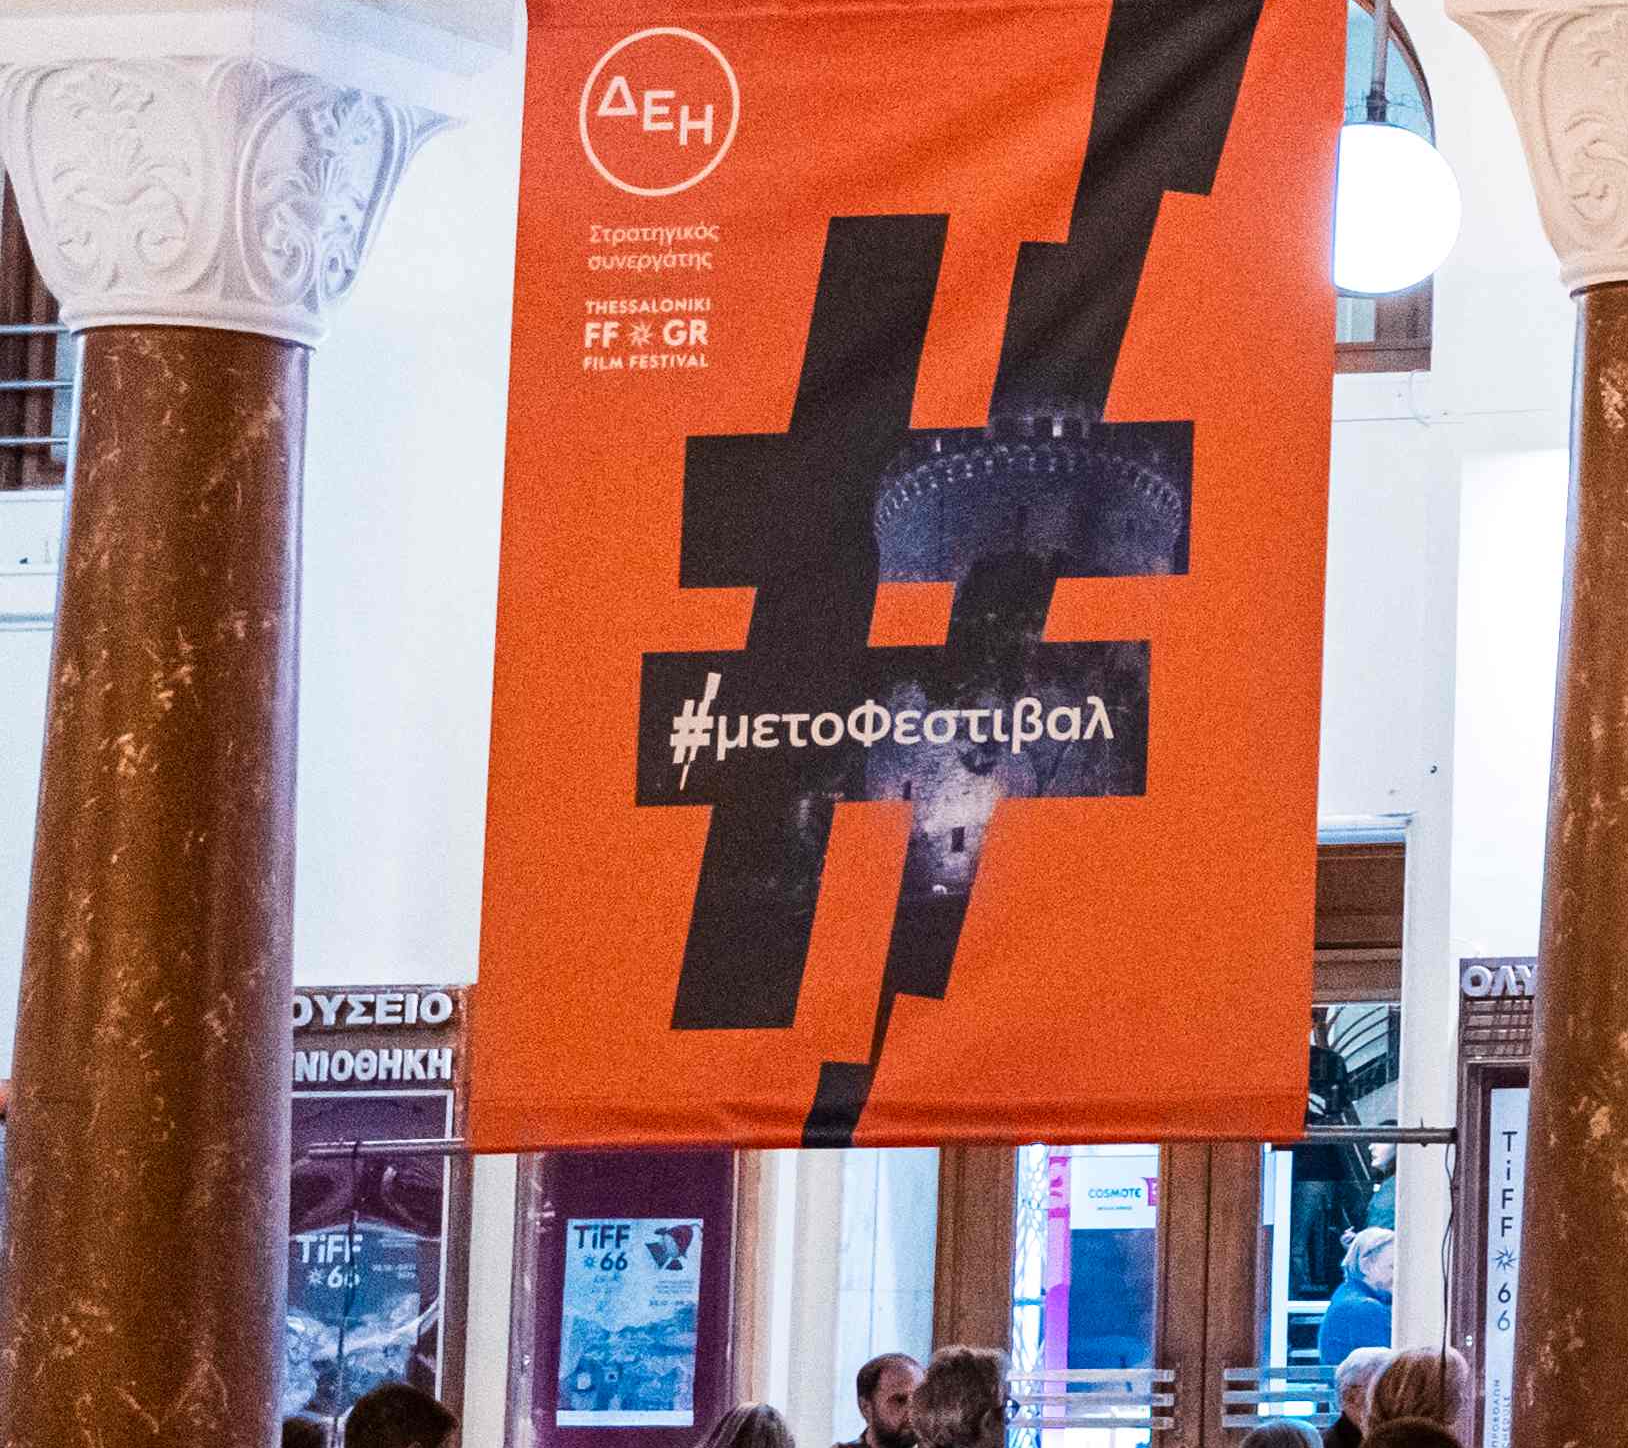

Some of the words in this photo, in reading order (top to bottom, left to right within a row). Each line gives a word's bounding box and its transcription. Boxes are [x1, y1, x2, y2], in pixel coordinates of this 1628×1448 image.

[597, 76, 714, 146] ΔΕΗ
[590, 221, 720, 247] Στρατηγικός
[587, 249, 713, 272] συνεργάτης
[585, 298, 711, 314] THESSALONIKI
[584, 321, 620, 349] FF
[662, 319, 709, 346] GR
[583, 355, 624, 371] FILM
[629, 353, 709, 370] FESTIVAL
[574, 1224, 630, 1249] TiFF
[601, 1252, 628, 1271] 66
